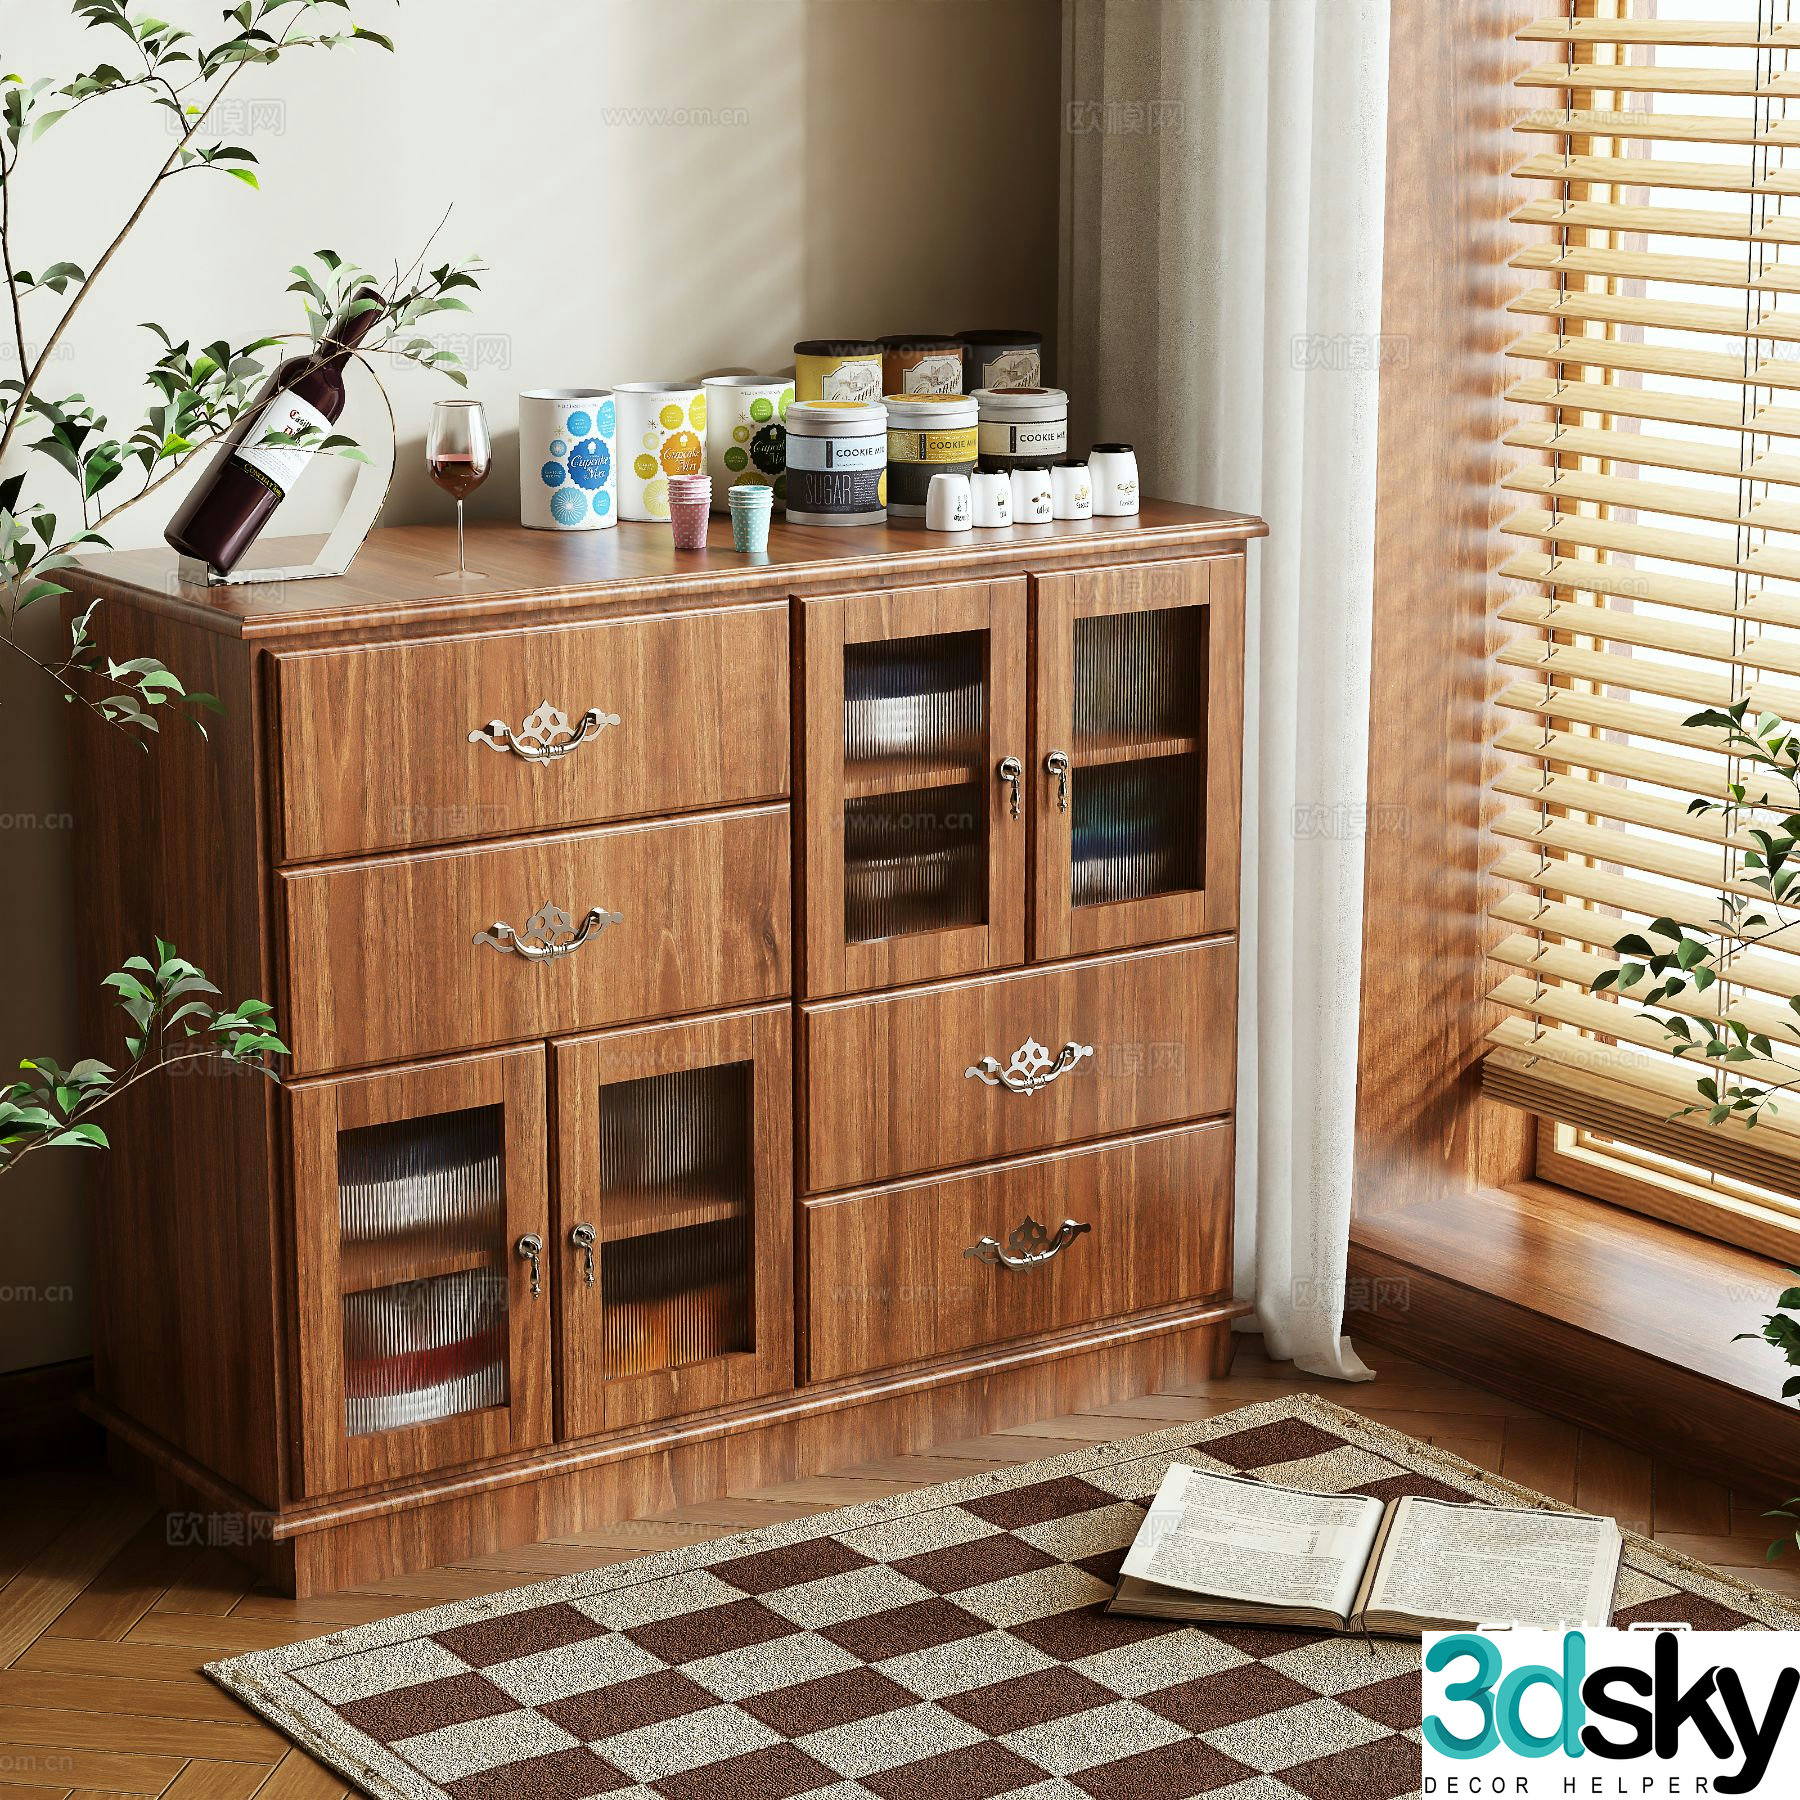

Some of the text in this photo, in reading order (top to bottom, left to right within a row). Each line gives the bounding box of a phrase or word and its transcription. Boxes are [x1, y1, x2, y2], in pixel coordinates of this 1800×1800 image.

[1019, 432, 1055, 443] COOKIE
[929, 440, 966, 450] COOKIE
[836, 447, 874, 458] COOKIE
[805, 473, 852, 505] SUGAR
